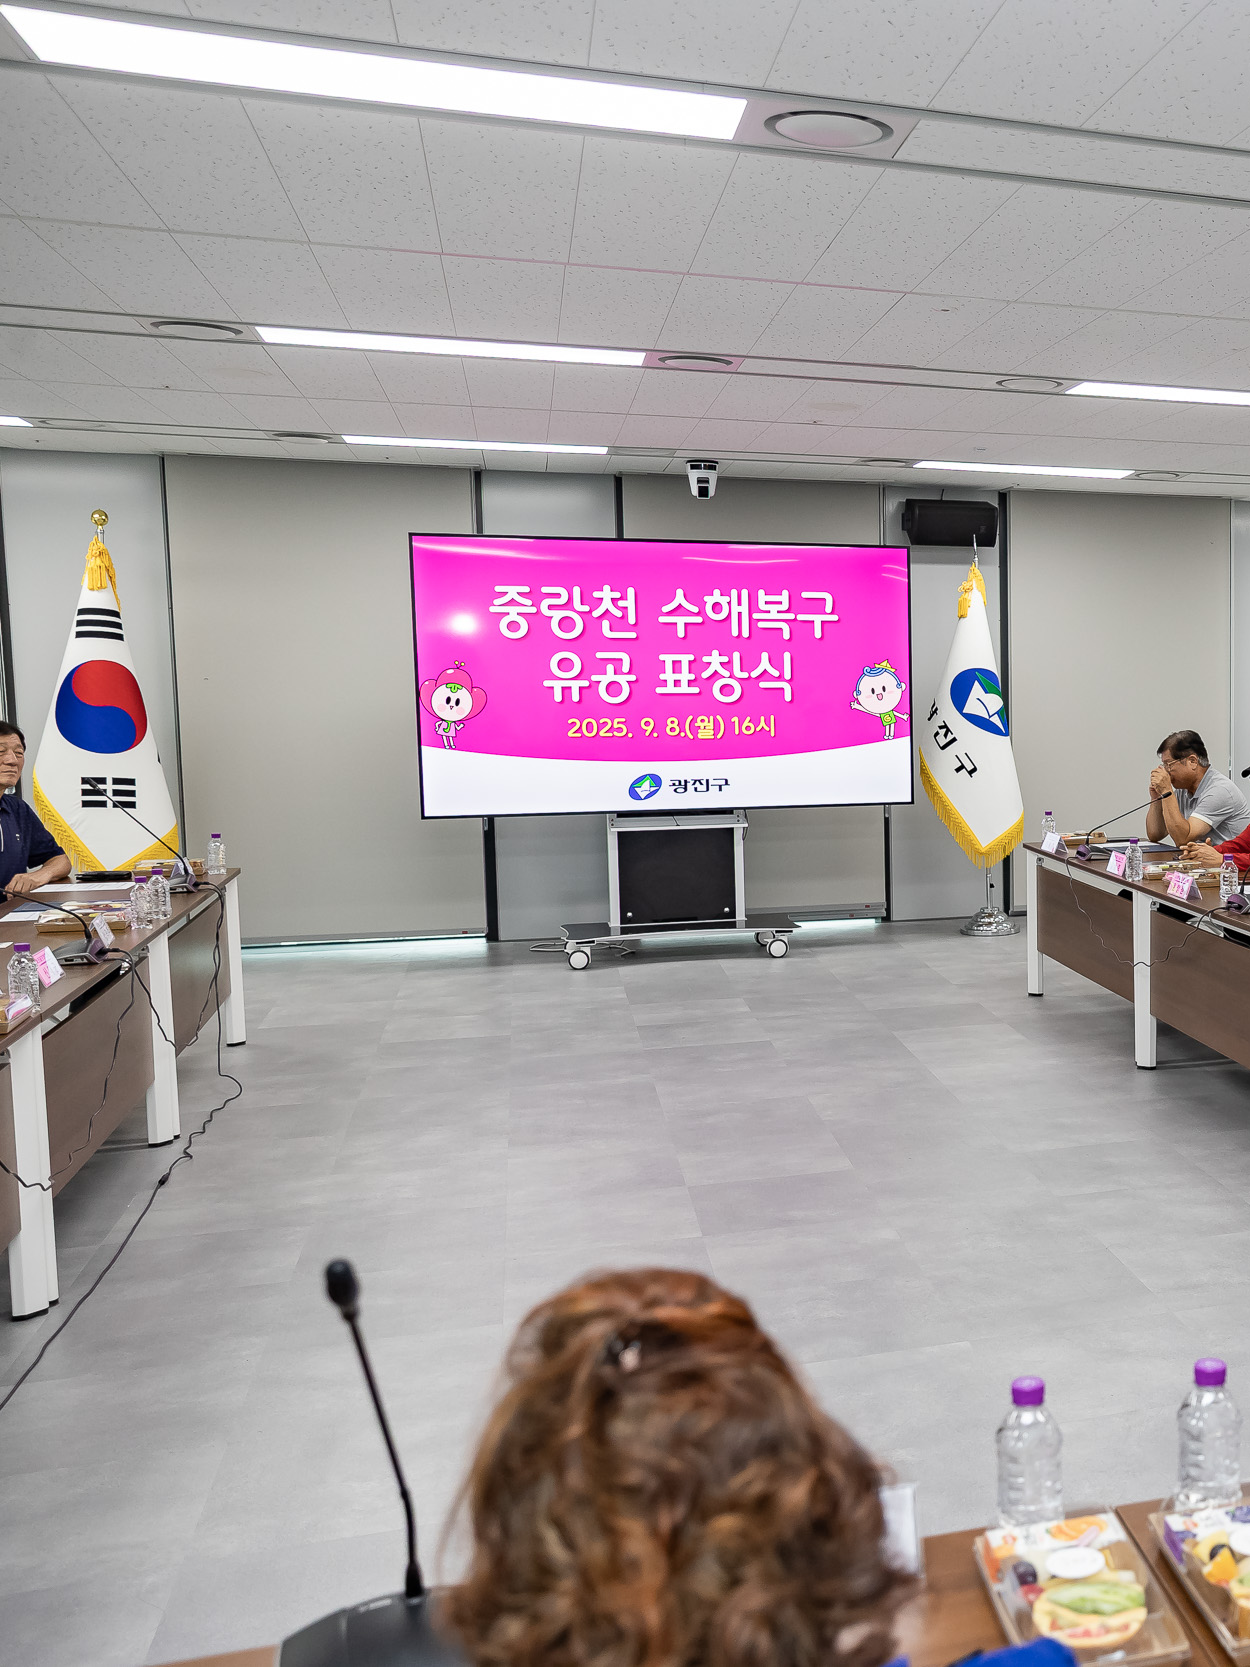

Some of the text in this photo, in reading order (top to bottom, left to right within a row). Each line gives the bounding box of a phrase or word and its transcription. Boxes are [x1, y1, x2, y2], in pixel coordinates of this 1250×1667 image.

[489, 585, 839, 641] 중랑천 수해복구
[543, 650, 792, 704] 유공 표창식
[567, 718, 633, 738] 2025.
[640, 717, 659, 738] 9.
[731, 715, 776, 737] 16시
[669, 778, 731, 794] 광진구
